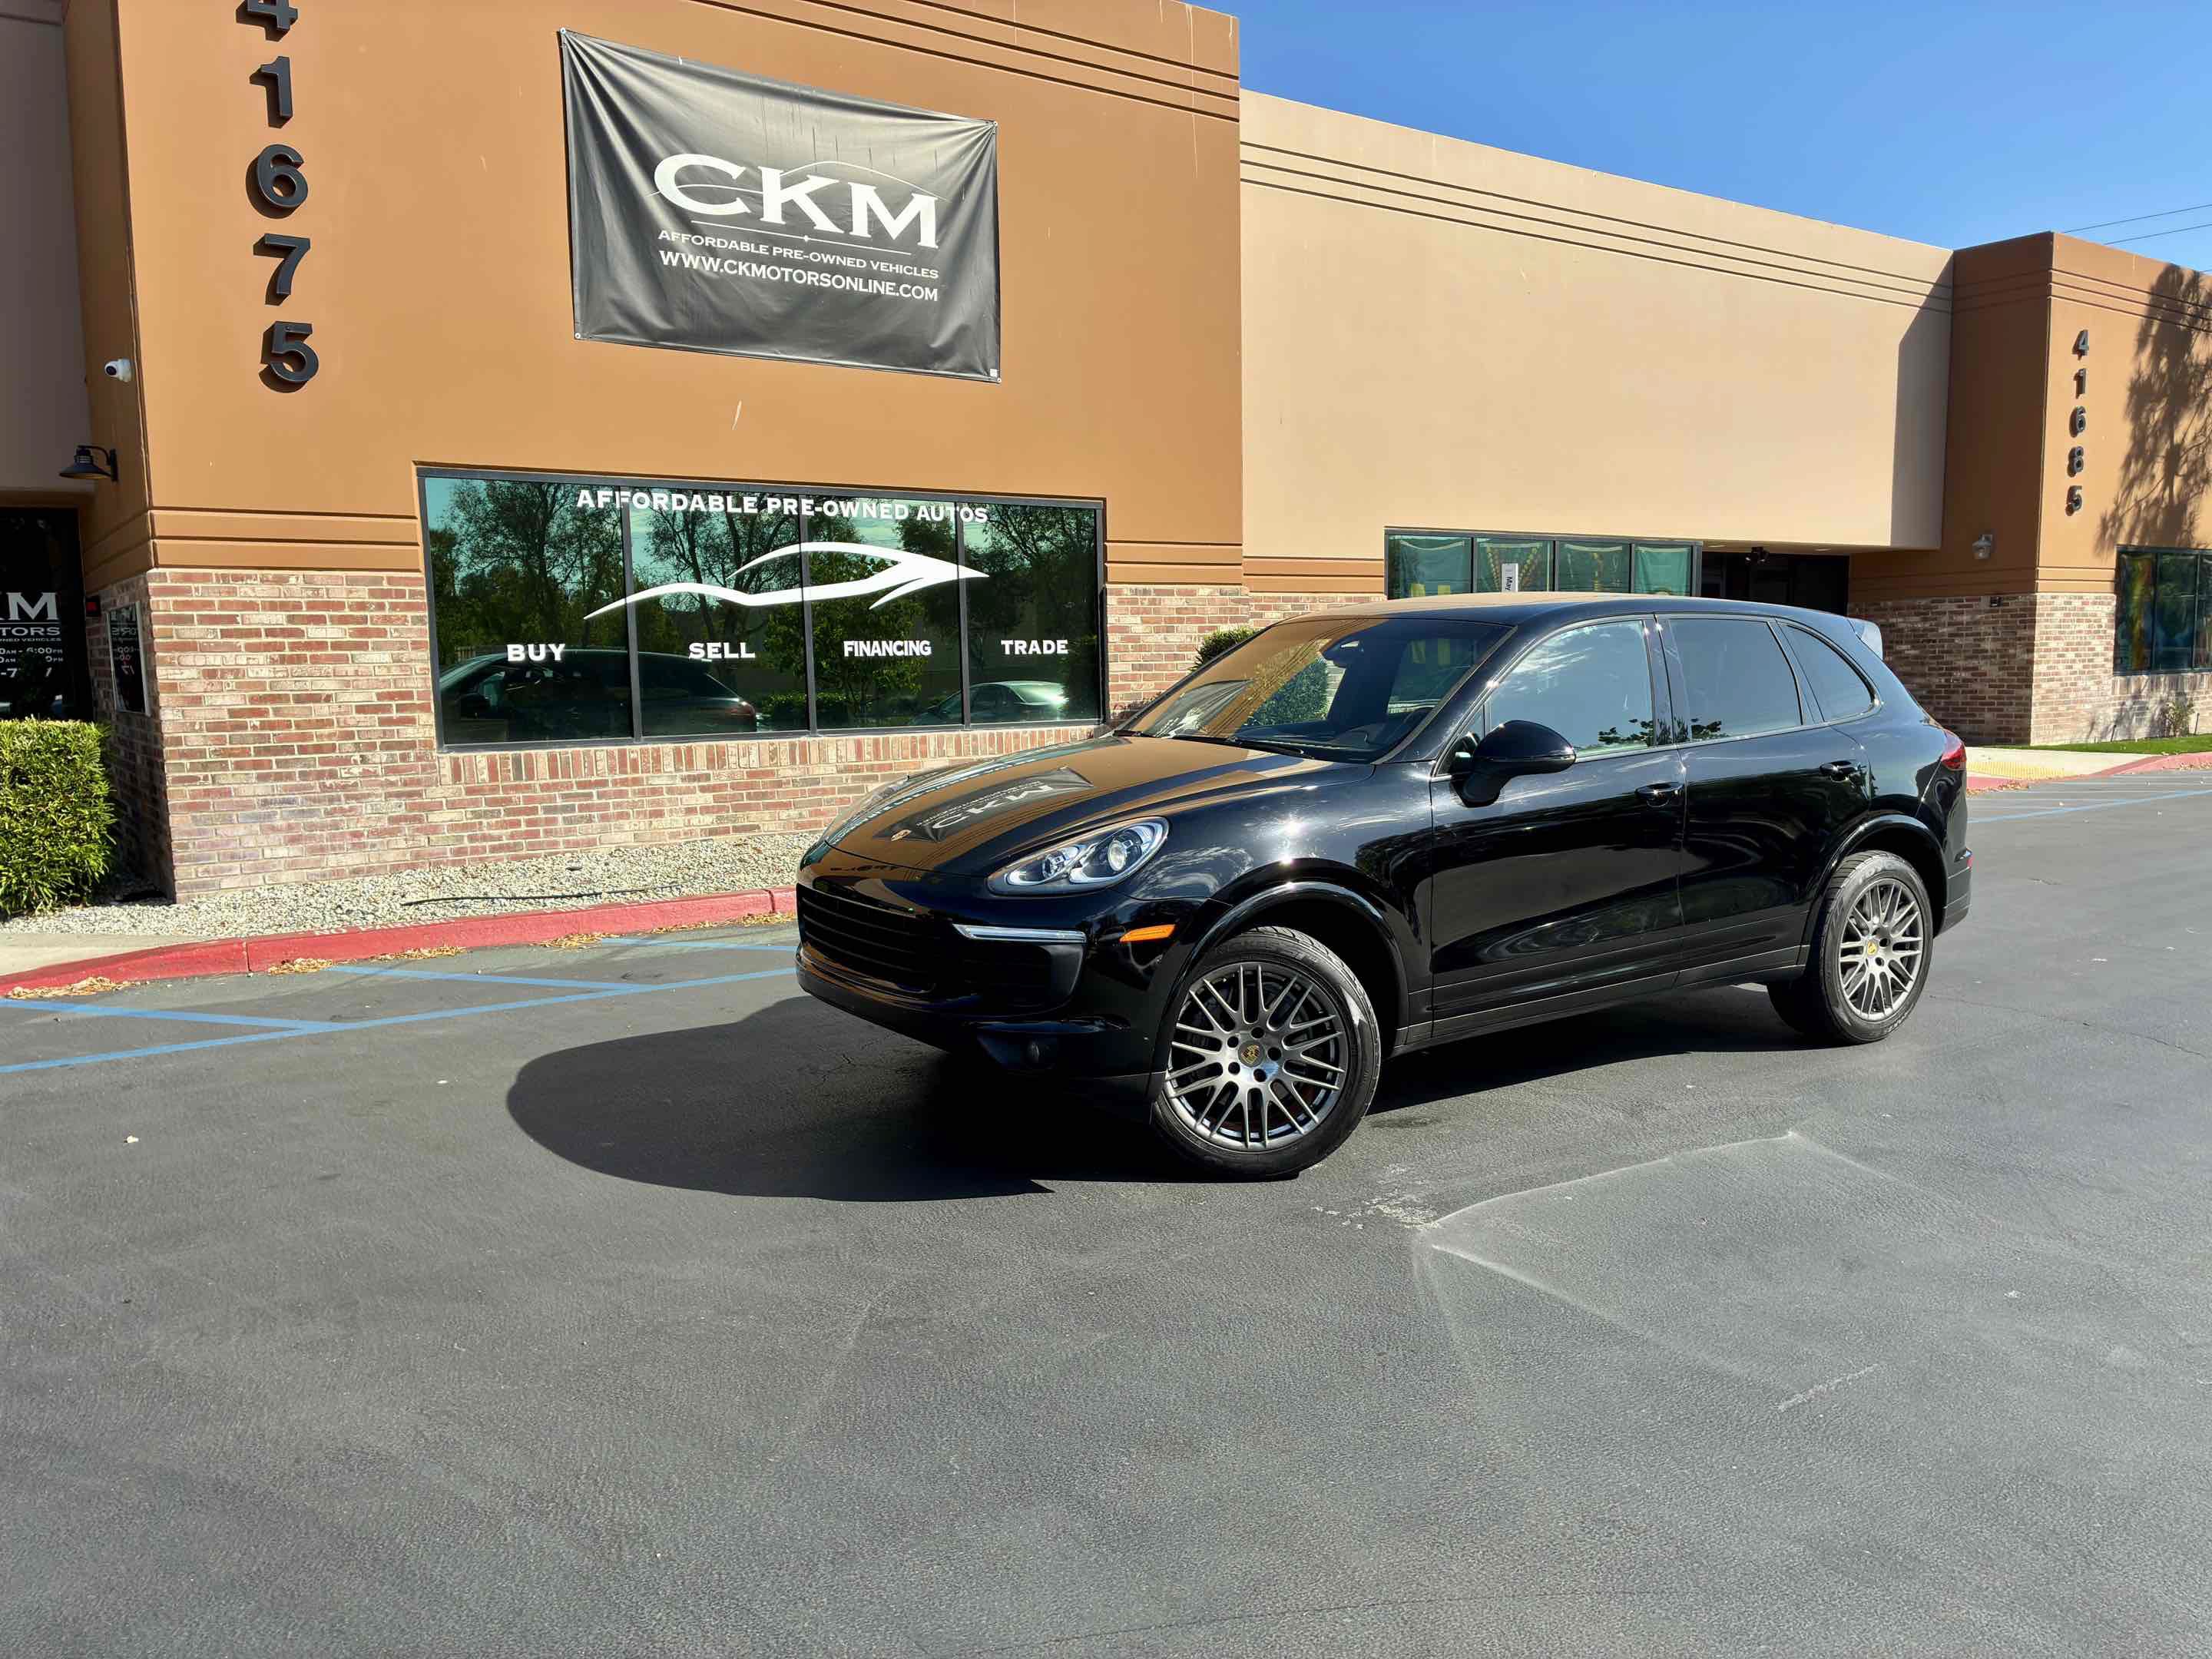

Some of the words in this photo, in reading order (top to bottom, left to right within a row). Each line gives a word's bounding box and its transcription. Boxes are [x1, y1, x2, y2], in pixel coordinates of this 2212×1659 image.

[654, 153, 939, 249] CKM
[657, 230, 769, 255] AFFORDABLE
[772, 247, 867, 268] PRE-OWNED
[869, 261, 939, 279] VEHICLES
[659, 250, 939, 301] WWW.CKMOTORSONLINE.COM
[576, 489, 758, 513] AFFORDABLE
[767, 498, 909, 520] PRE-OWNED
[916, 505, 989, 523] AUTOS
[507, 644, 565, 661] BUY
[688, 642, 756, 660] SELL
[843, 640, 932, 657] FINANCING
[1001, 639, 1069, 655] TRADE
